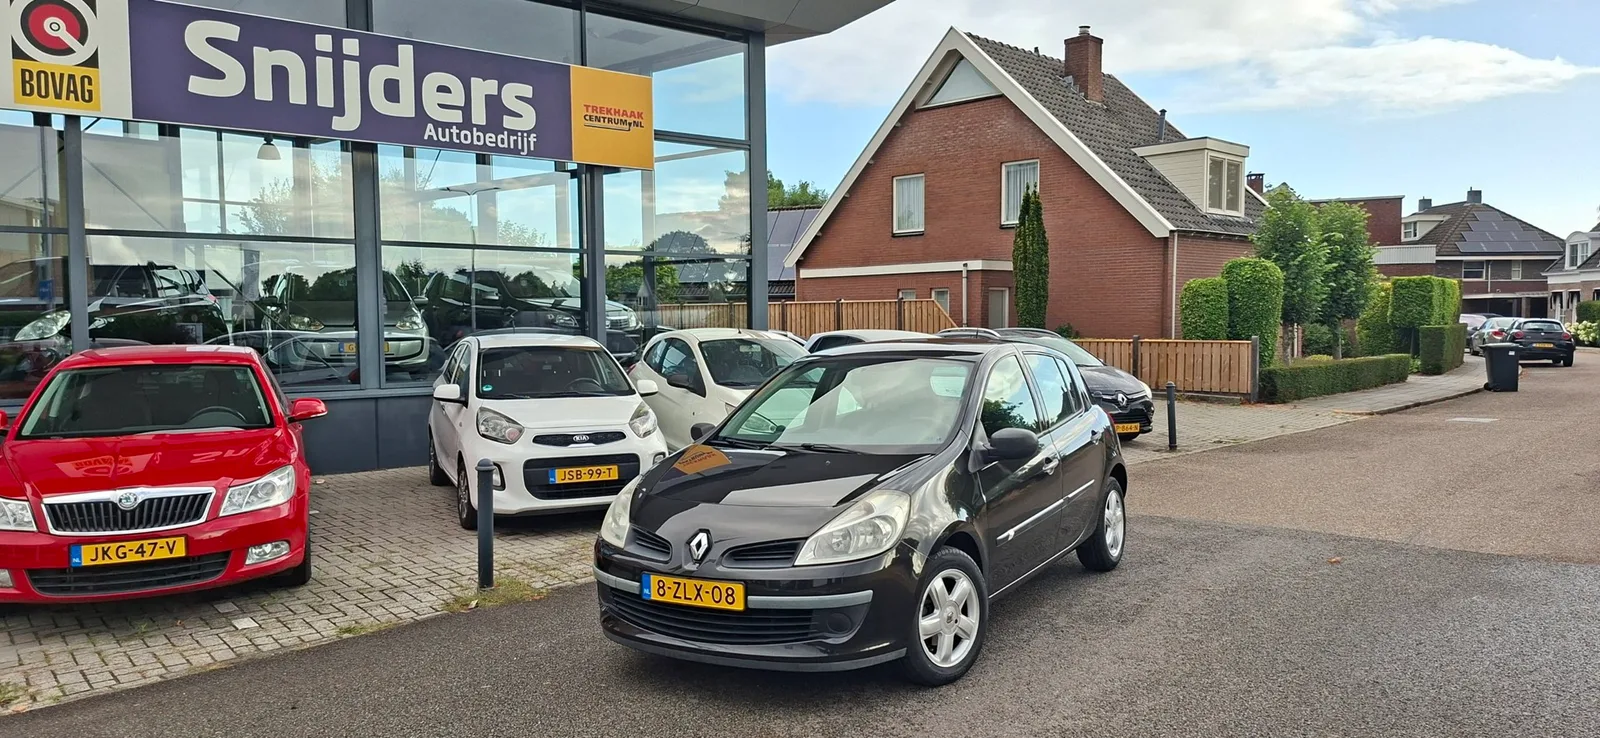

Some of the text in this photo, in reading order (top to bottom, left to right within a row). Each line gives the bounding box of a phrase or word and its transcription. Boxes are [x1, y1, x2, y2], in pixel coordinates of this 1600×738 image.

[20, 68, 94, 103] BOVAG
[184, 20, 537, 131] Snijders
[583, 104, 644, 120] TREKHAAK
[423, 123, 537, 156] Autobedrijf
[560, 467, 613, 481] JSB-99-T
[90, 540, 177, 562] JKG-47-V
[656, 579, 736, 606] 8-ZLX-08
